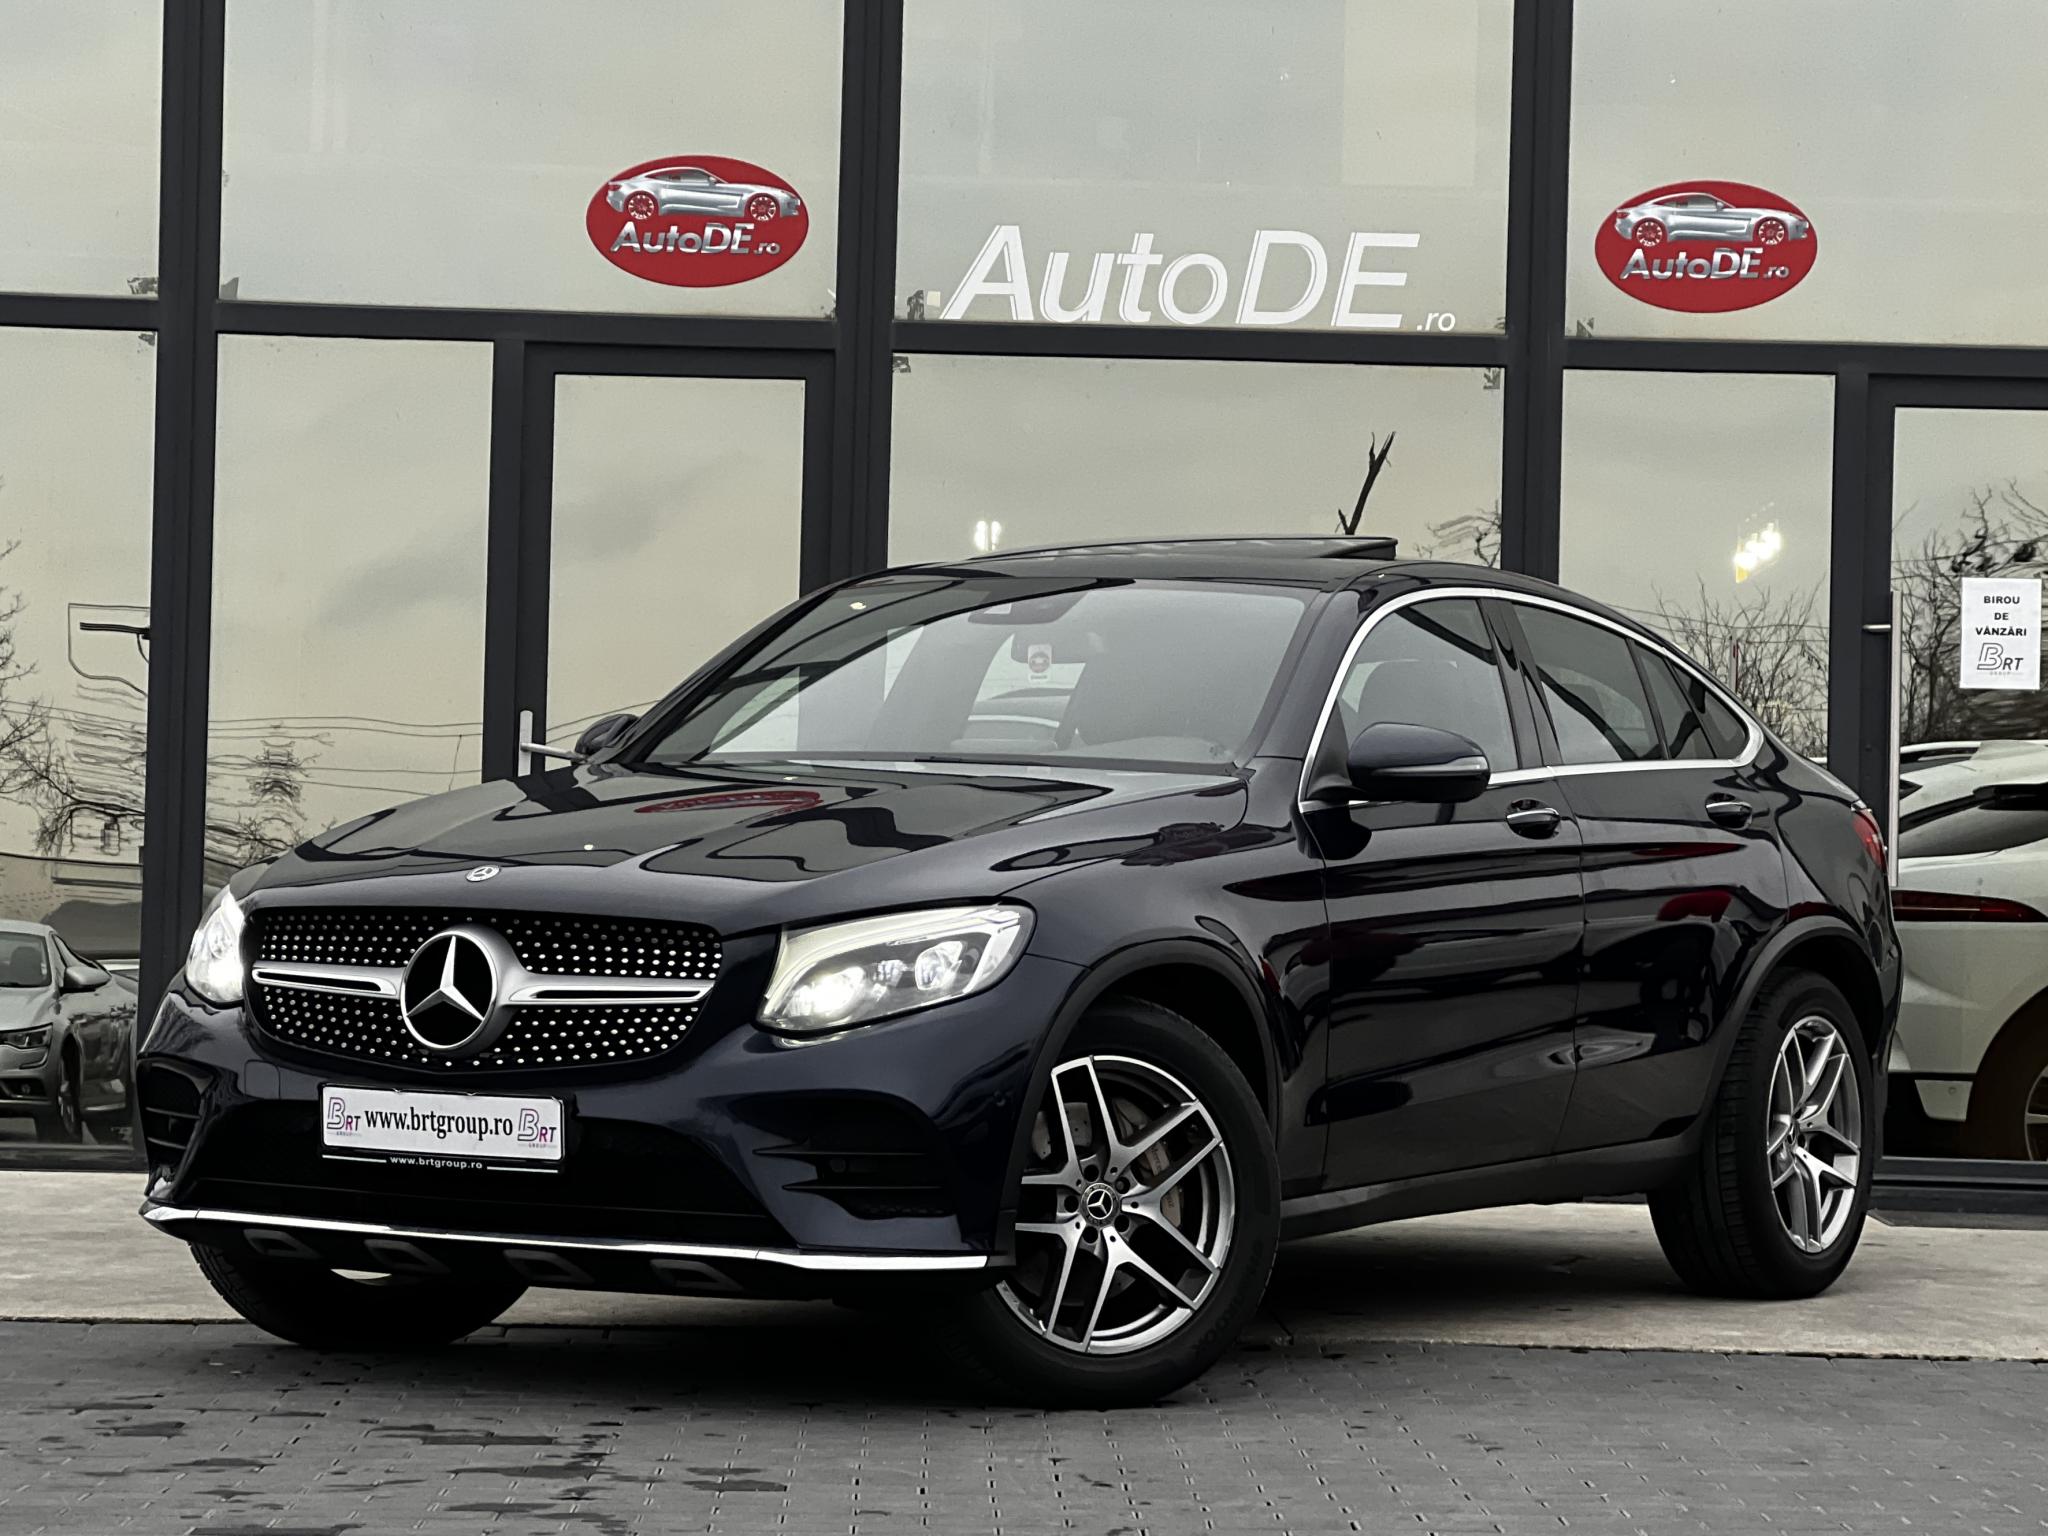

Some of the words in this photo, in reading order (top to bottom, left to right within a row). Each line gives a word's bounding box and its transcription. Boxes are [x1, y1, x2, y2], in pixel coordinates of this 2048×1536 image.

[1983, 595, 2021, 605] BIROU
[1994, 612, 2009, 621] DE
[364, 1106, 514, 1141] www.brtgroup.ro
[389, 1155, 483, 1170] www.brtgroup.ro
